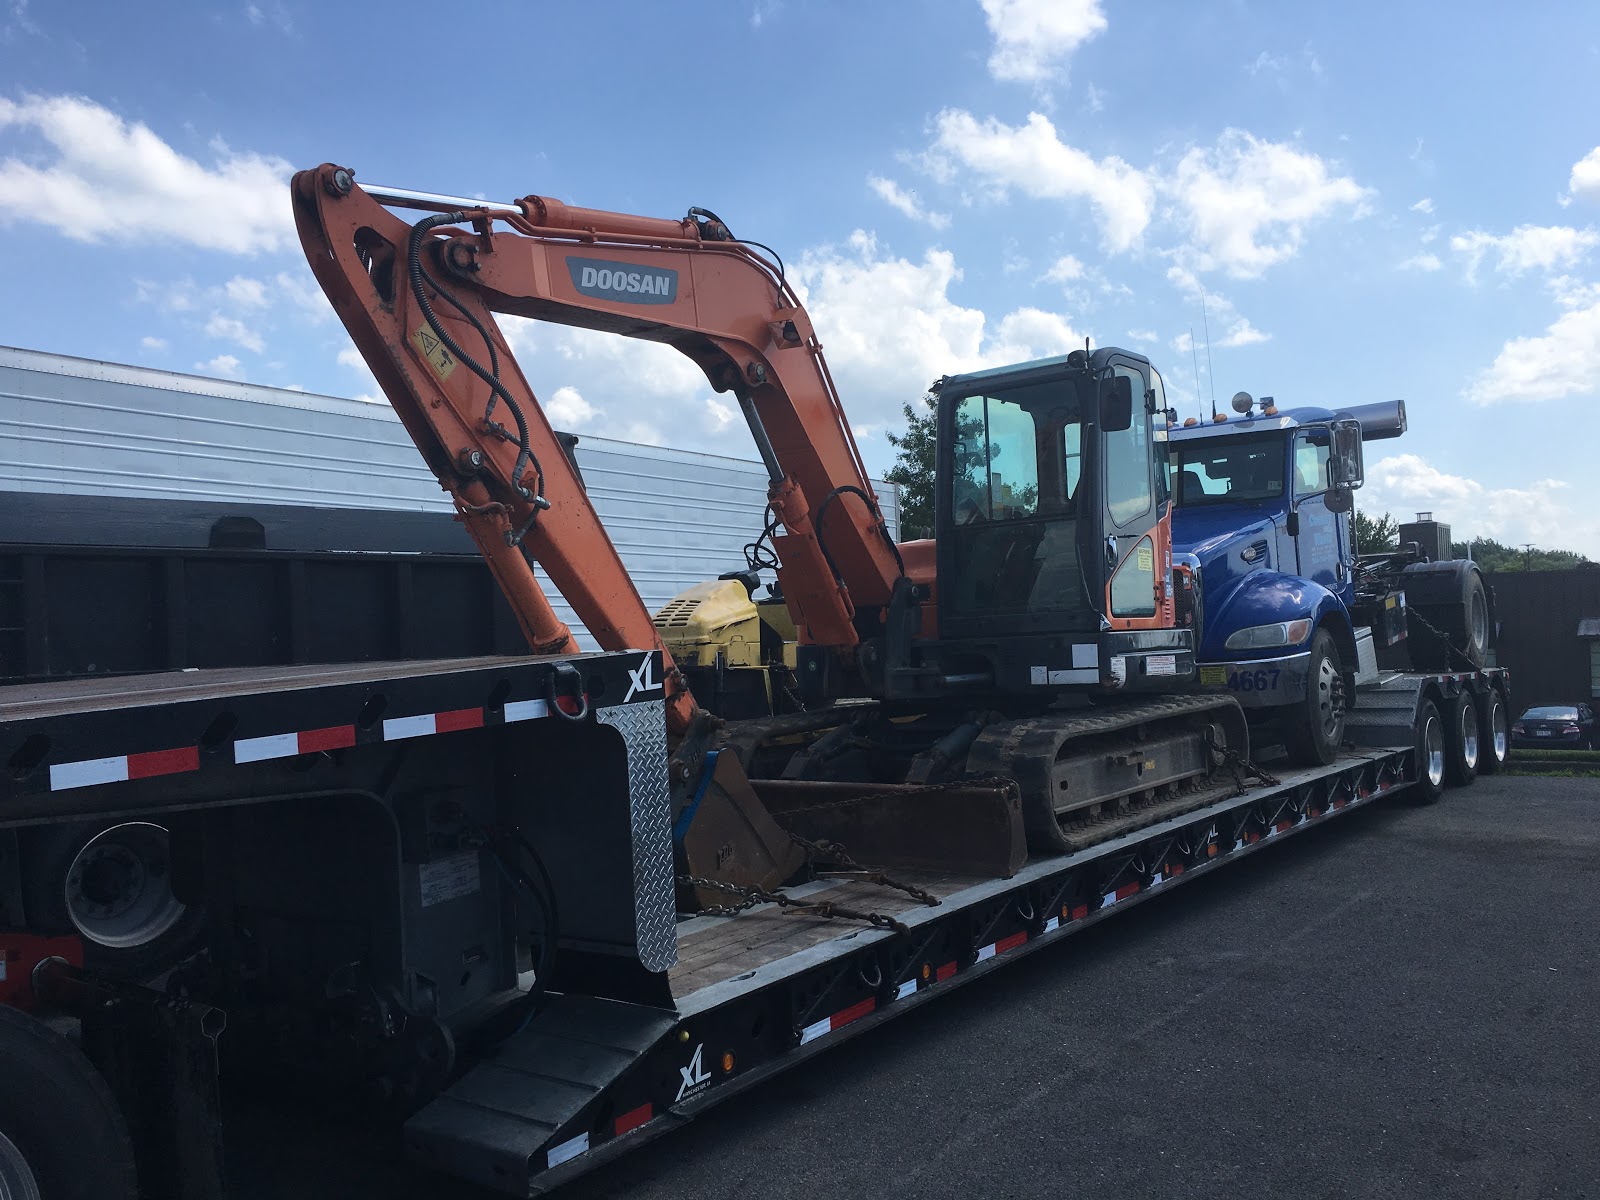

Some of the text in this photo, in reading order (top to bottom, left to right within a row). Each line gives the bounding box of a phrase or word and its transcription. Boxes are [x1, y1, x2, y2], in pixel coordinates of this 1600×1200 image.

[581, 266, 670, 296] DOOSAN
[623, 651, 663, 703] XL
[1228, 668, 1281, 692] 4667
[674, 1043, 712, 1103] XL
